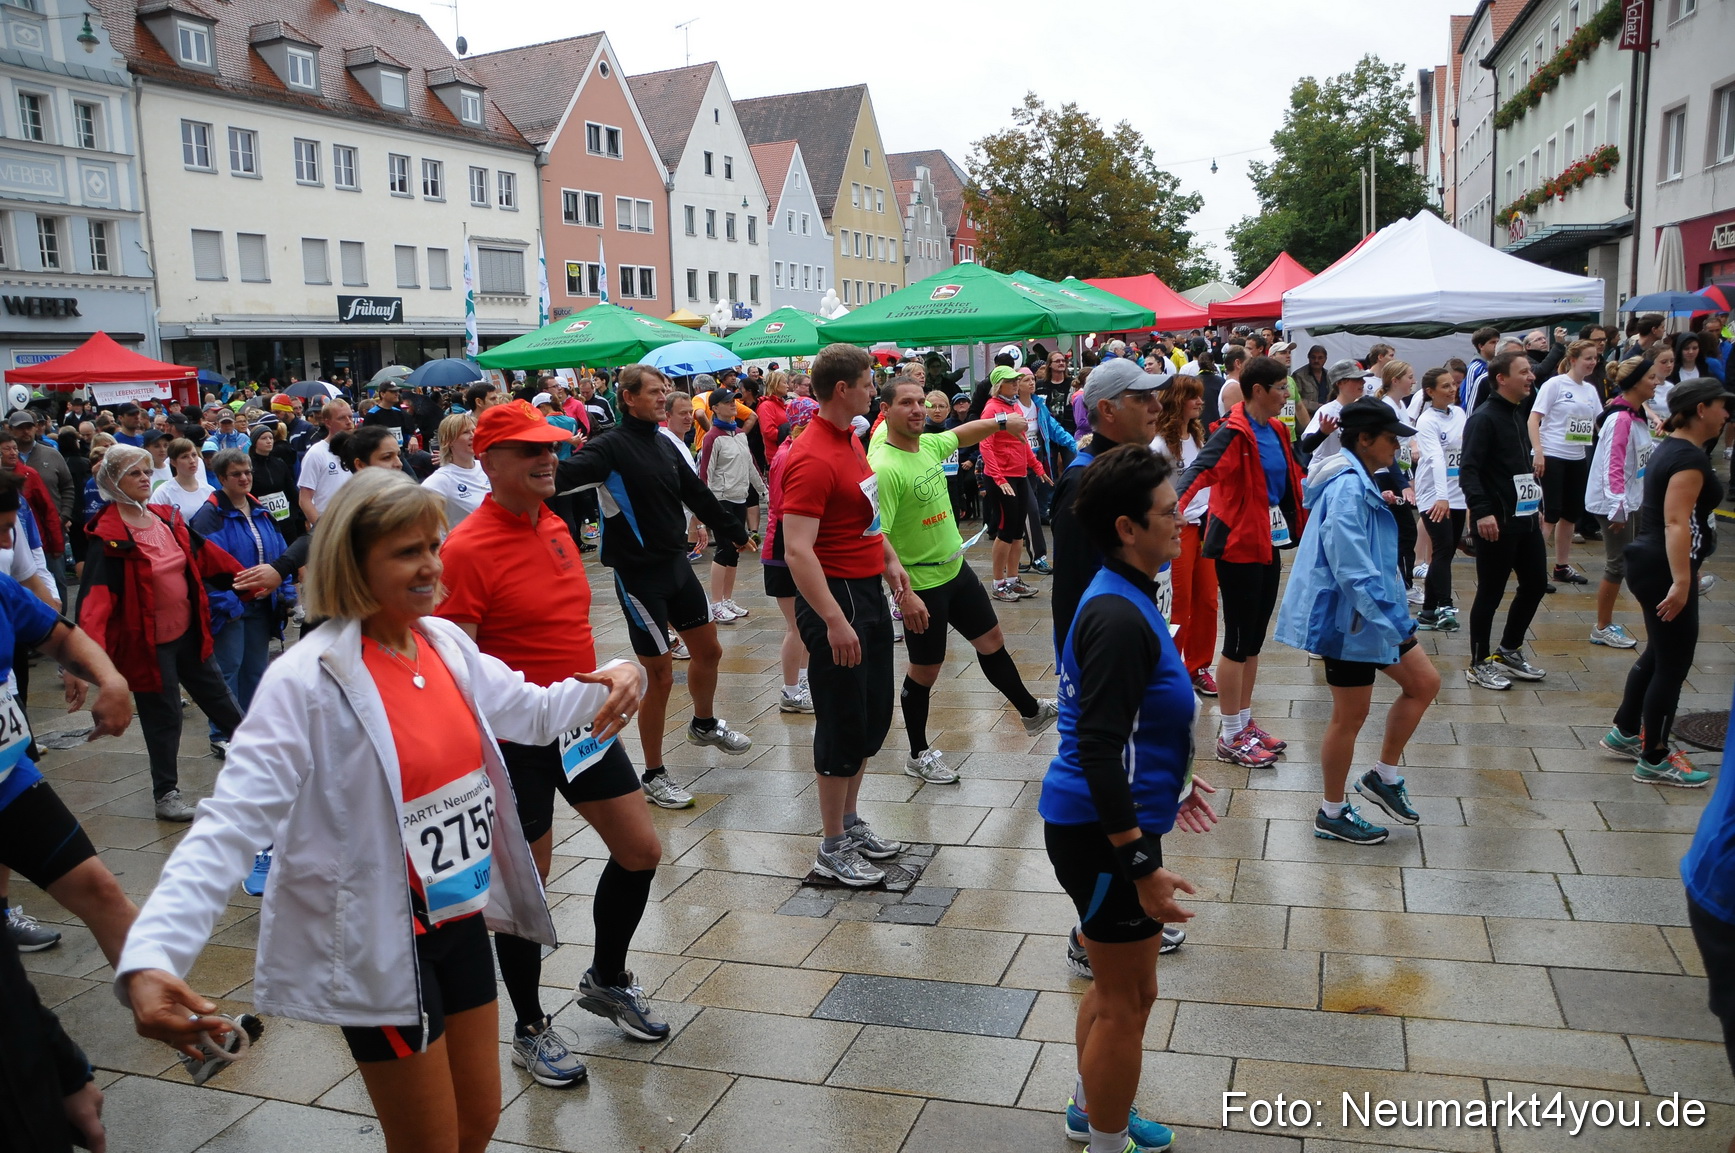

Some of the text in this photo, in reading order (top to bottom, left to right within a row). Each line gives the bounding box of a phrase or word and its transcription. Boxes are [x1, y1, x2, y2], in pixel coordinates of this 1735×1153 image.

[2, 295, 83, 319] WEBER
[343, 298, 401, 321] frühauf
[885, 307, 979, 319] Lammsbräu
[904, 301, 971, 311] Neumarkter
[739, 338, 797, 348] Lammsbräu
[1570, 421, 1592, 434] 5035
[922, 511, 948, 526] MERZ
[577, 740, 598, 758] Karl
[403, 781, 485, 829] PARTL Neumarkt
[420, 795, 494, 875] 2756
